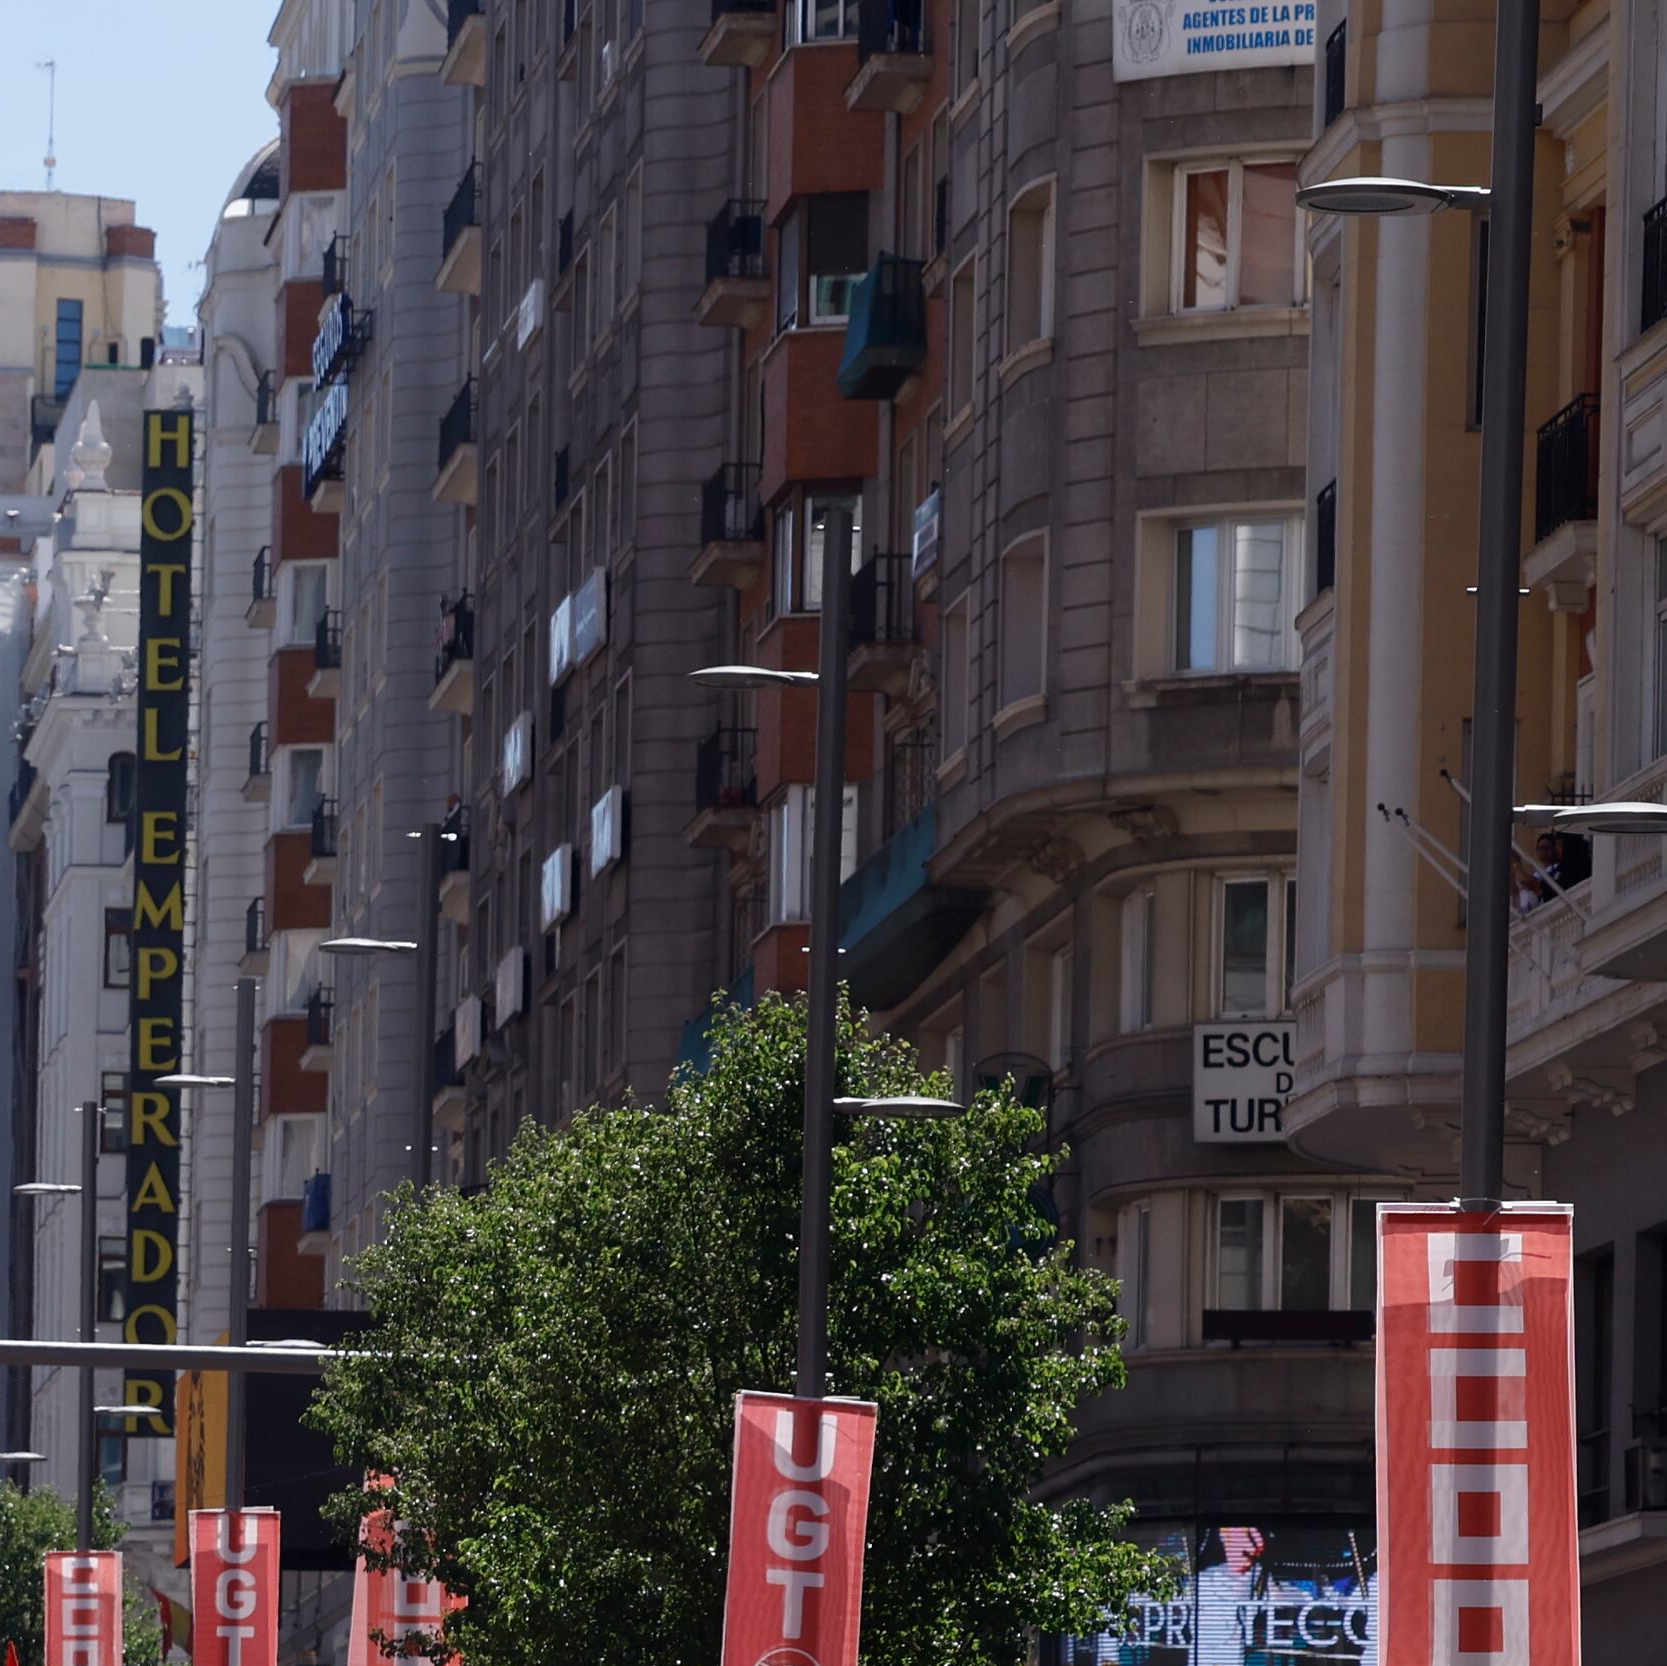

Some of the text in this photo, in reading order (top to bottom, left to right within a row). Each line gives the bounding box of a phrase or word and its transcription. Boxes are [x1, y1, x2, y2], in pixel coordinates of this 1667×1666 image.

[1183, 7, 1245, 30] AGENTES
[1251, 5, 1270, 24] DE
[1273, 4, 1291, 22] LA
[1187, 29, 1315, 54] INMOBILIARIA DE
[125, 413, 193, 1435] HOTEL EMPERADOR
[766, 1410, 837, 1640] UGT
